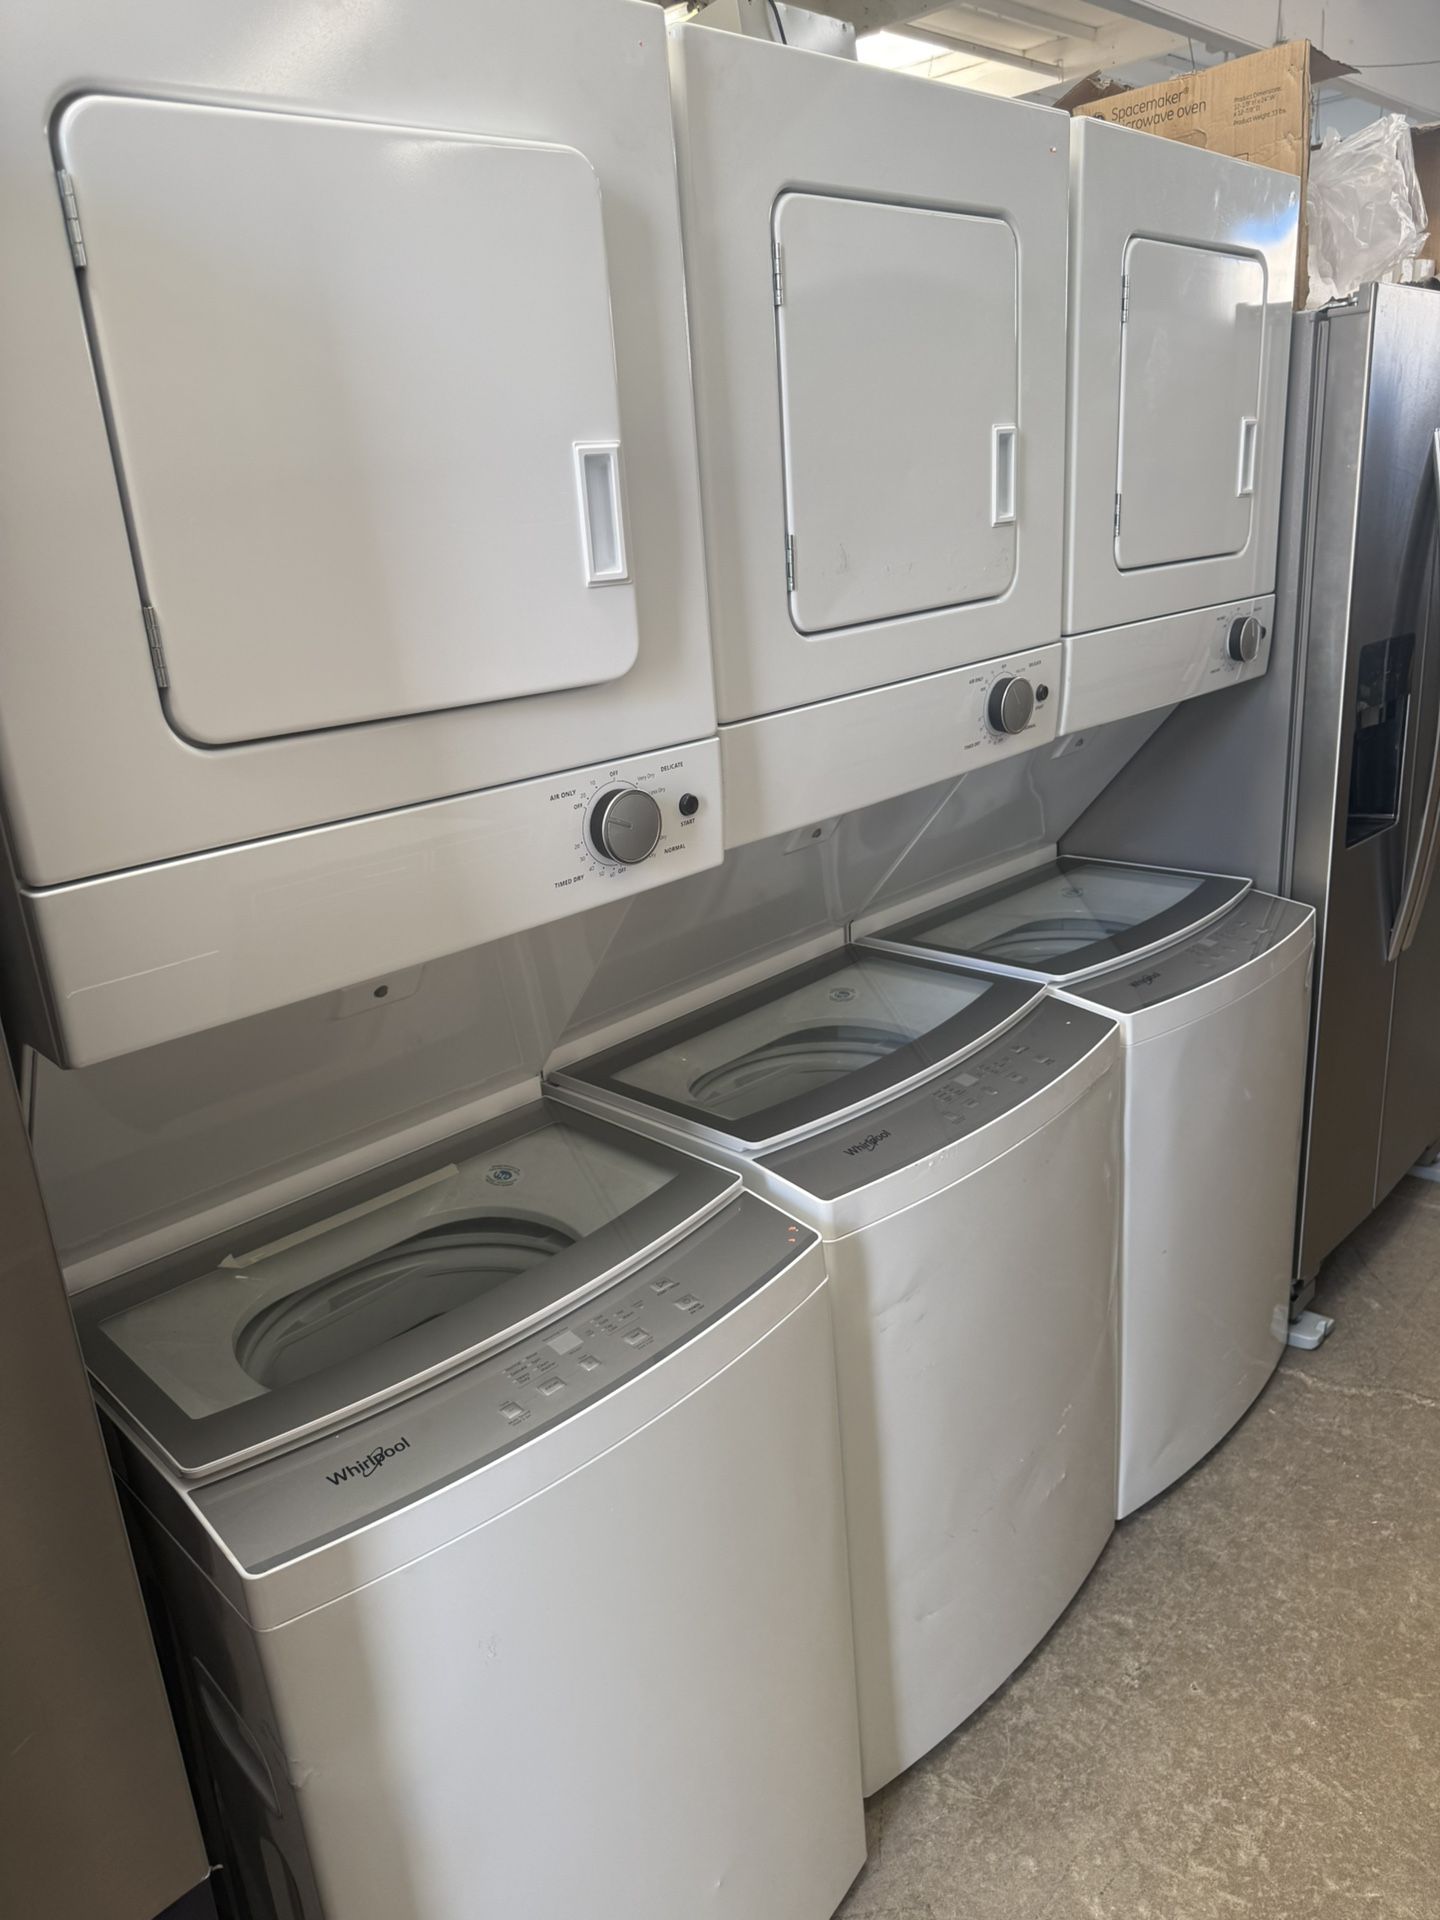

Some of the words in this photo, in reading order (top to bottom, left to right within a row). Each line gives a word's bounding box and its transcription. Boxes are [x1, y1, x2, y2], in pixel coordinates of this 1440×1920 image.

[1177, 98, 1207, 118] oven
[660, 761, 684, 772] DELICATE
[550, 793, 560, 802] AIR
[561, 789, 576, 798] ONLY
[680, 818, 695, 827] START
[664, 843, 686, 854] NORMAL
[554, 878, 572, 888] TIMED
[573, 874, 585, 882] DRY
[843, 1129, 892, 1156] Whirlpool
[326, 1436, 412, 1488] Whirlpool
